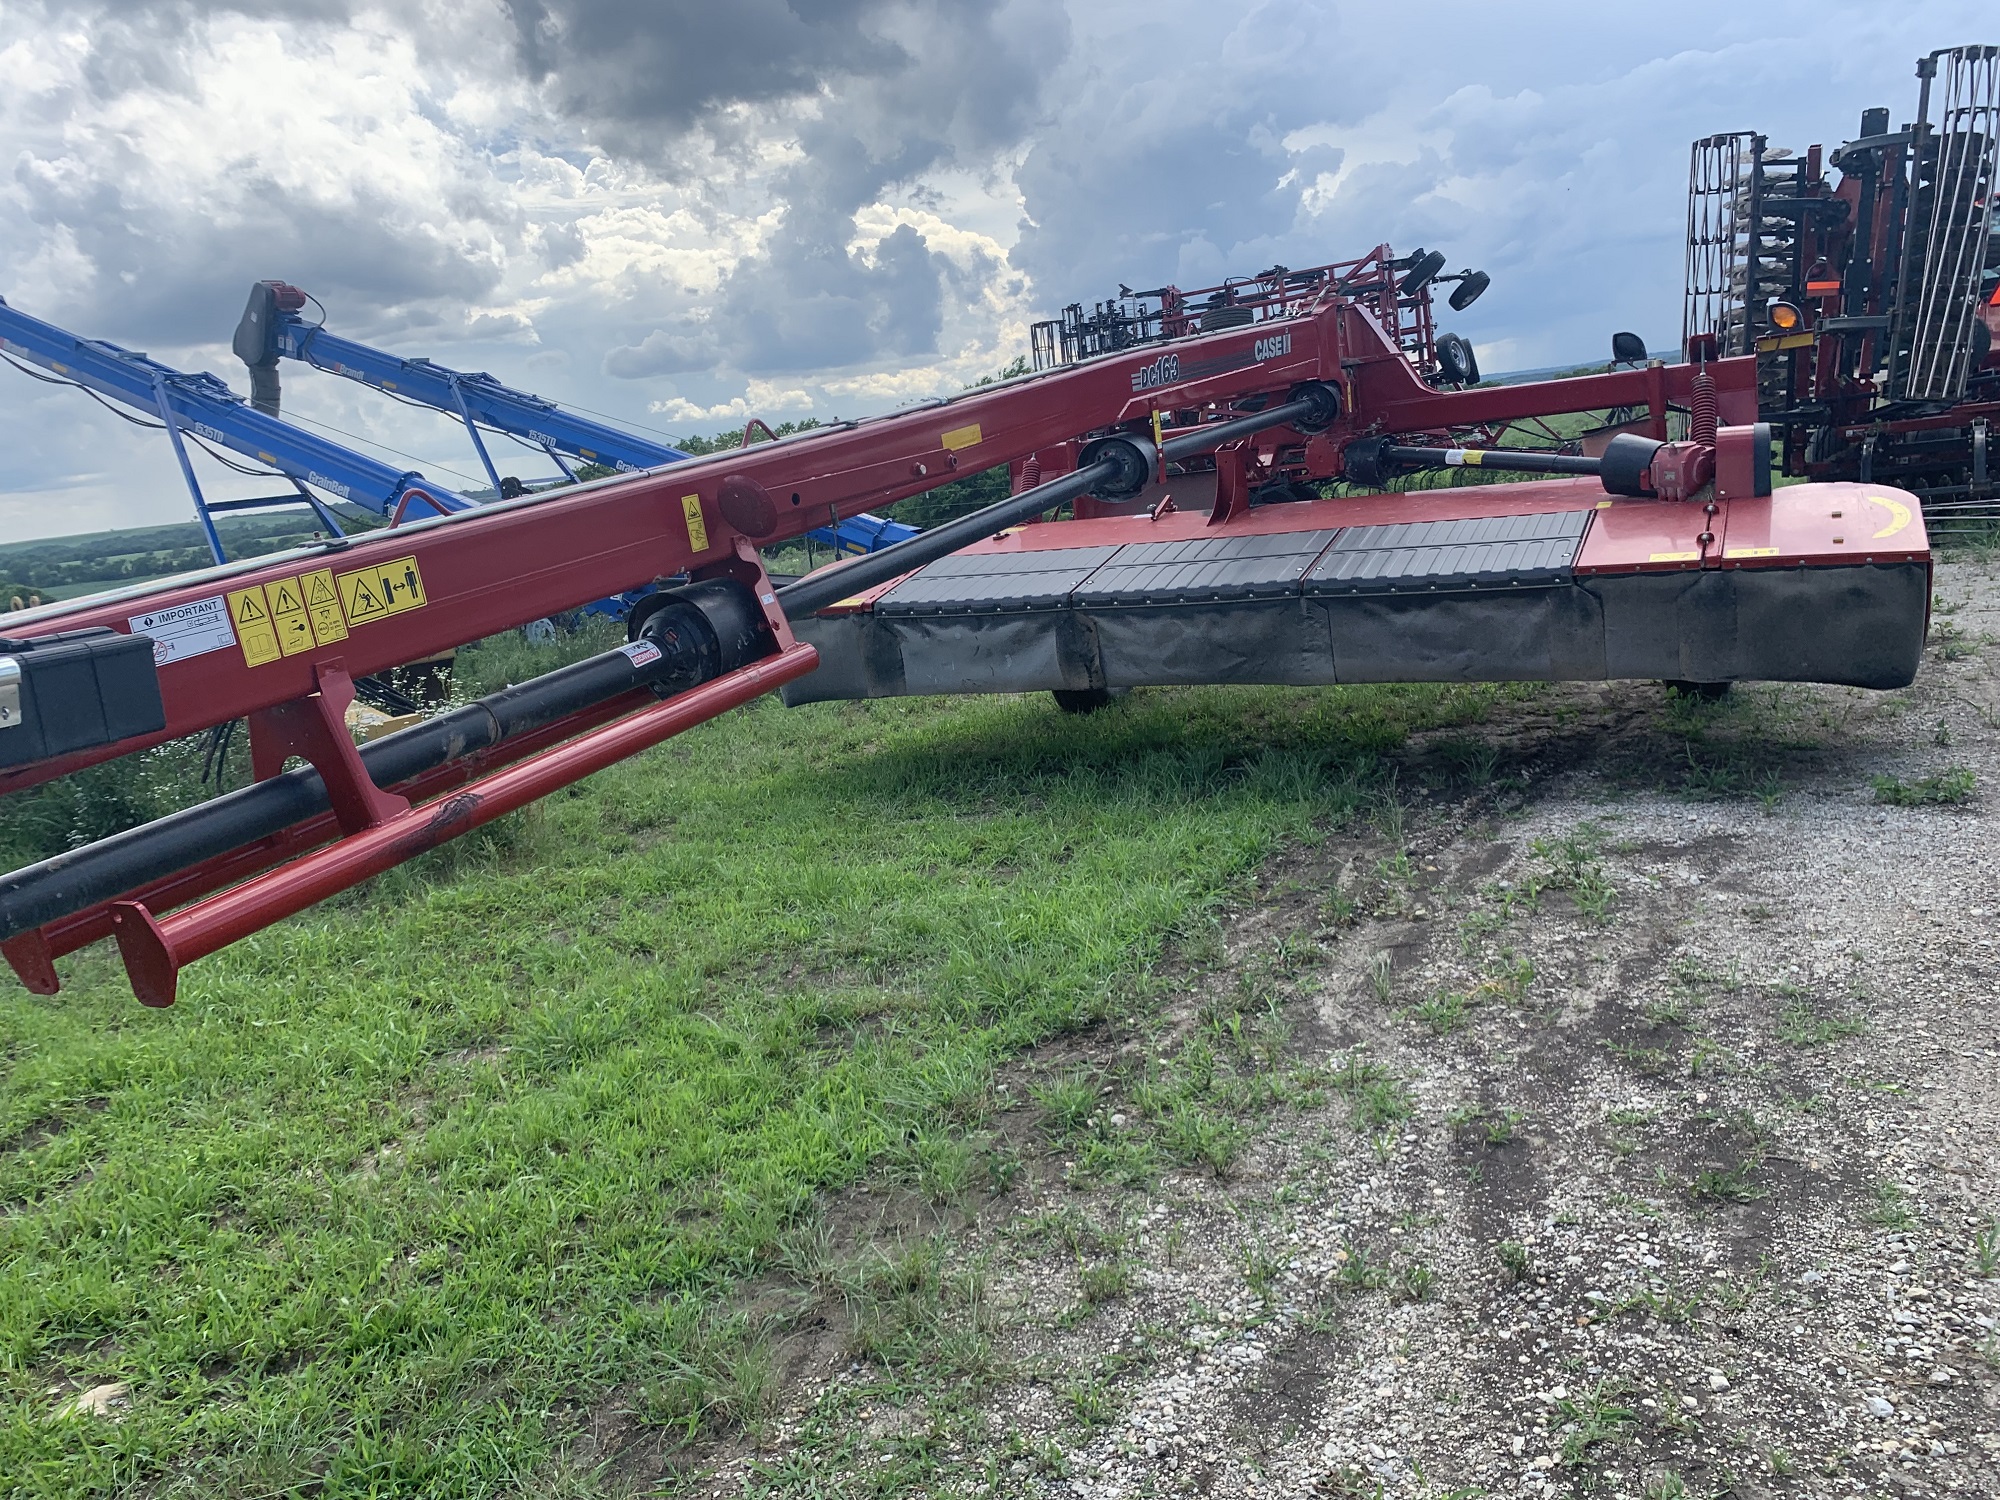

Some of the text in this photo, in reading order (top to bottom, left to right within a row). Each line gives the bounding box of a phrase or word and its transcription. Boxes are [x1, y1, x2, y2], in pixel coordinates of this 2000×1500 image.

[1254, 335, 1282, 362] CASE
[340, 363, 365, 381] Brandt
[1140, 354, 1180, 389] DC163
[194, 421, 224, 443] 1535TD
[529, 429, 557, 447] 1535TD
[308, 470, 350, 498] GrainBelt
[158, 601, 217, 623] IMPORTANT
